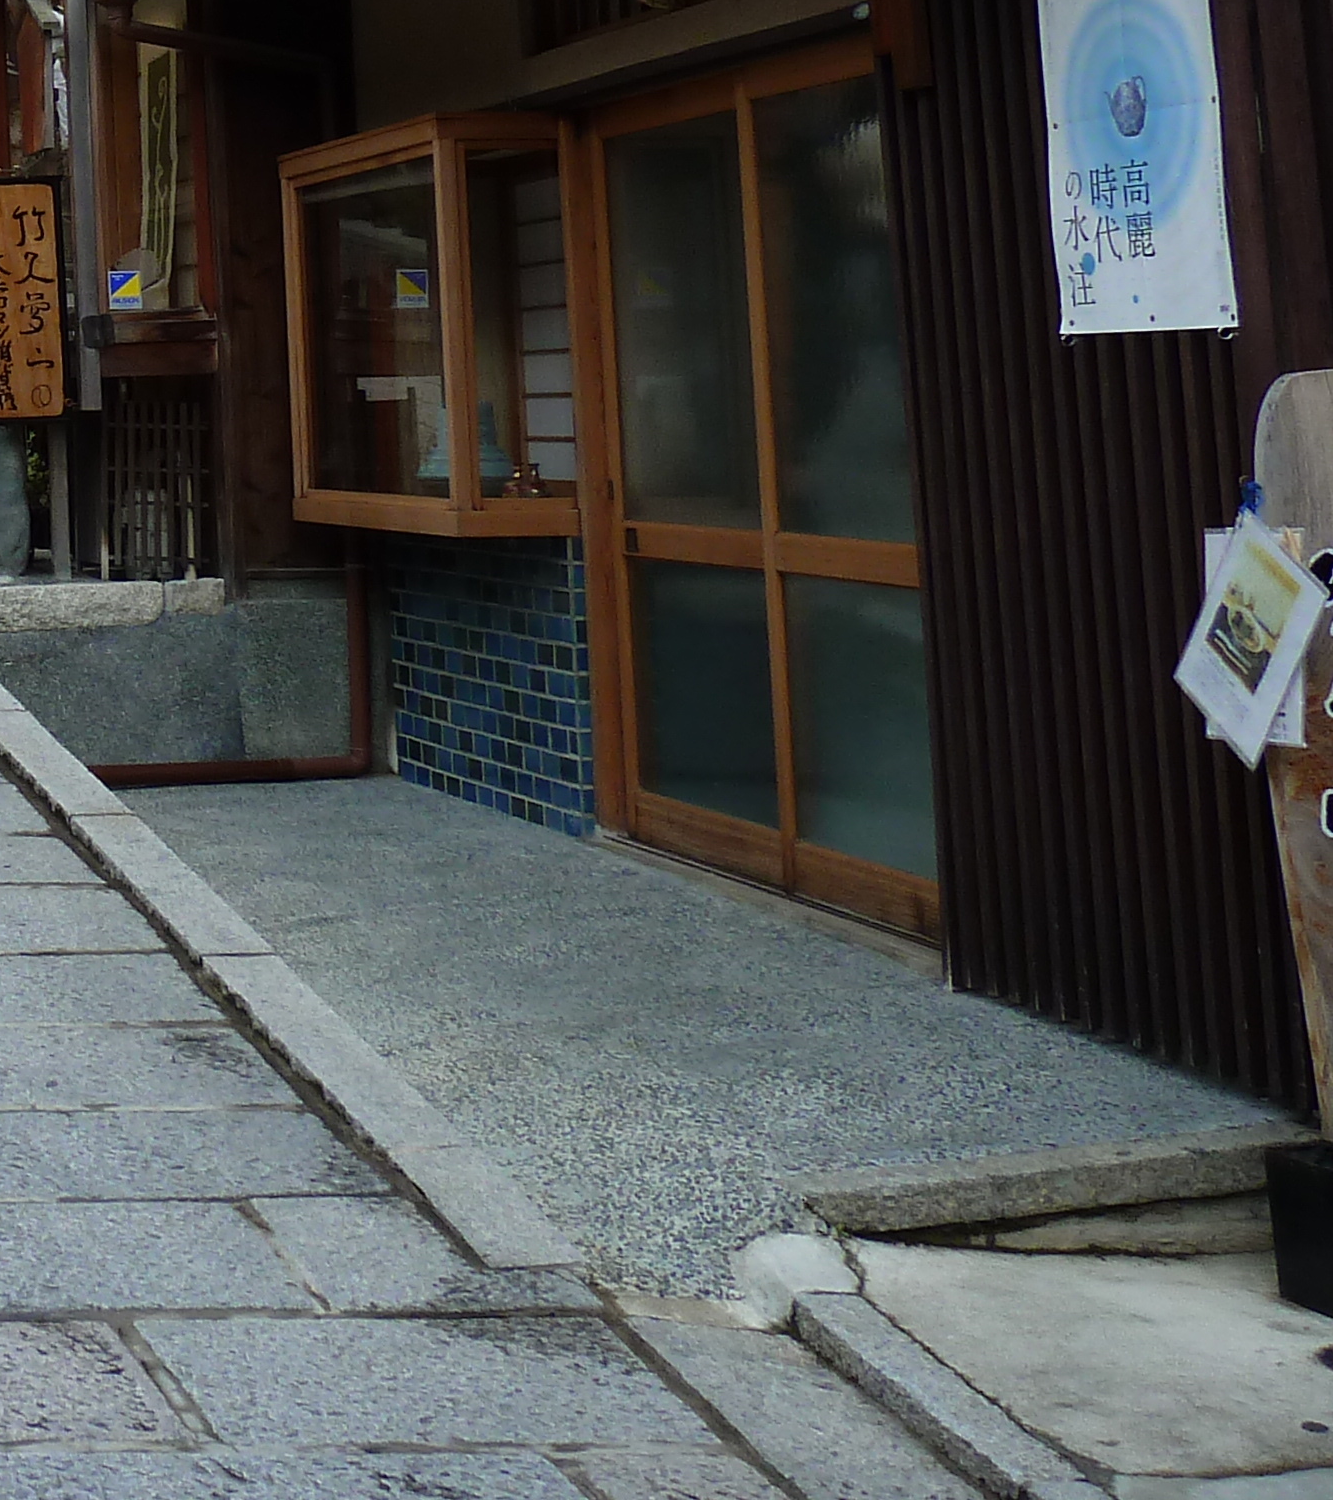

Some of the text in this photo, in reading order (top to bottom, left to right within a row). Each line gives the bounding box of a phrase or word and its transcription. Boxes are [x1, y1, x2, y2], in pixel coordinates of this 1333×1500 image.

[1062, 171, 1097, 308] の水注
[1089, 163, 1123, 263] 時代
[1120, 159, 1156, 258] 高麗
[12, 206, 56, 369] 竹久夢二
